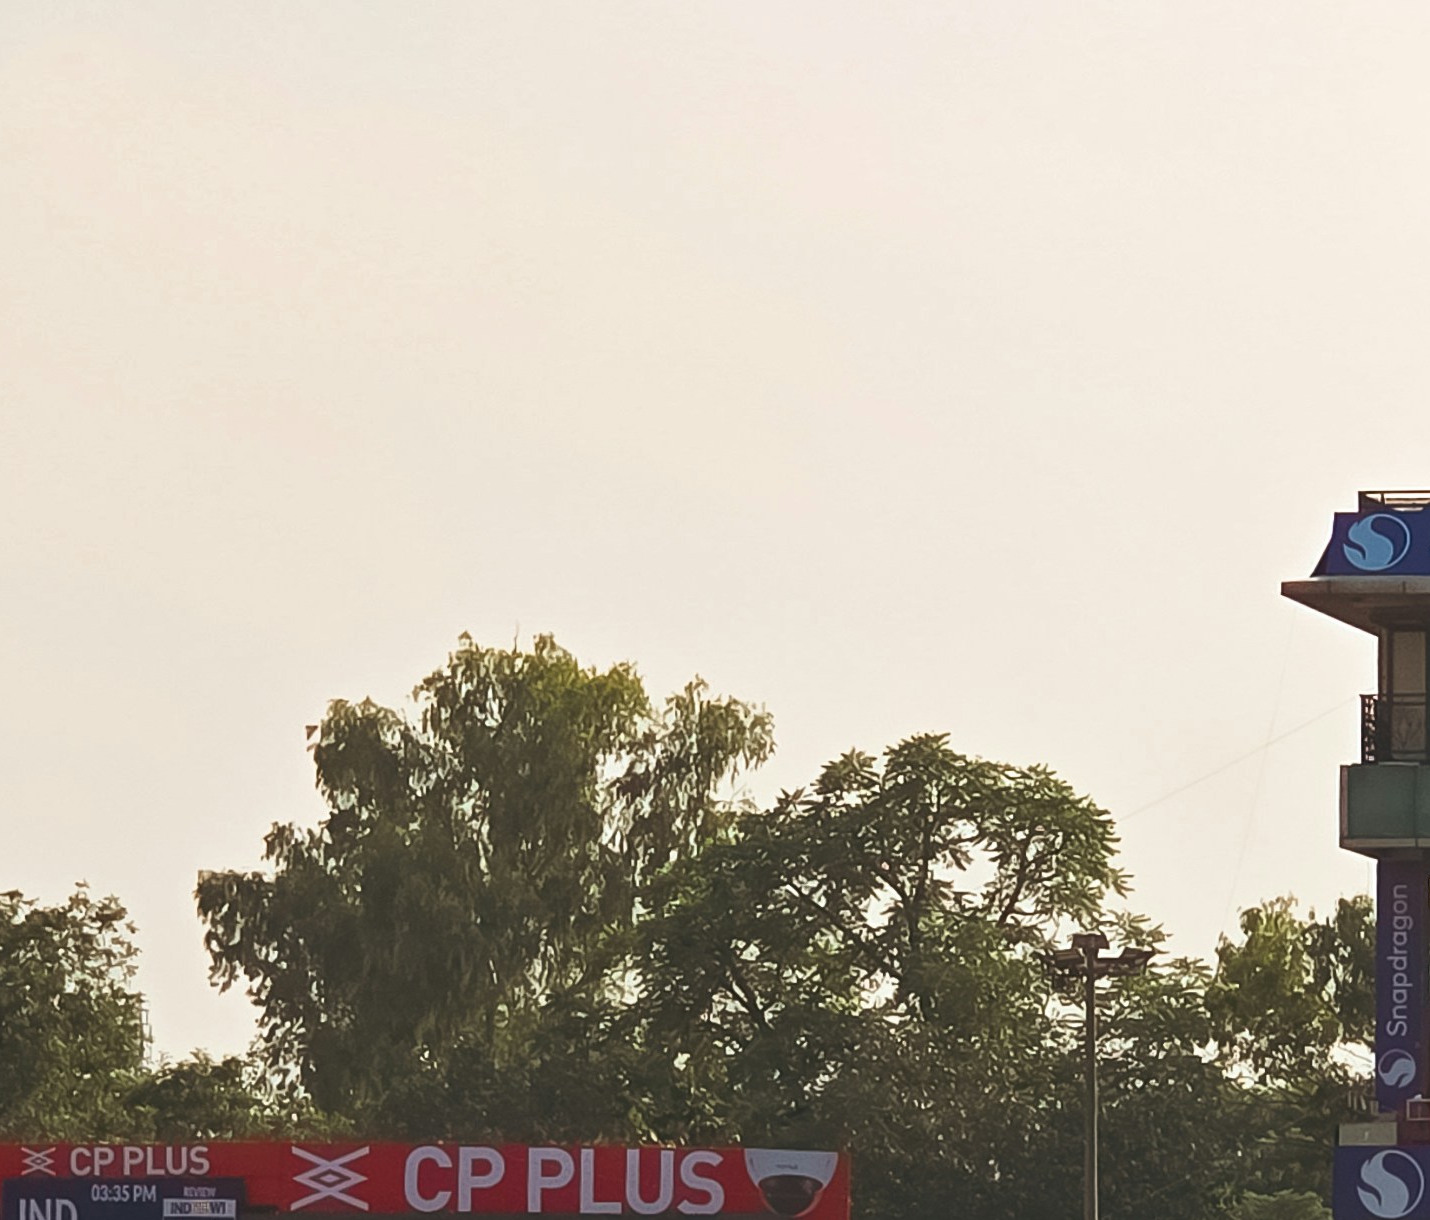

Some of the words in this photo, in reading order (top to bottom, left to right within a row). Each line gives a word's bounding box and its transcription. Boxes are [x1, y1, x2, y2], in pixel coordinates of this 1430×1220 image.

[1386, 884, 1408, 1036] Snapdragon
[70, 1147, 115, 1176] CP
[123, 1147, 210, 1176] PLUS
[406, 1148, 504, 1213] CP
[528, 1148, 727, 1215] PLUS
[91, 1185, 129, 1201] 03:35
[133, 1186, 157, 1201] PM
